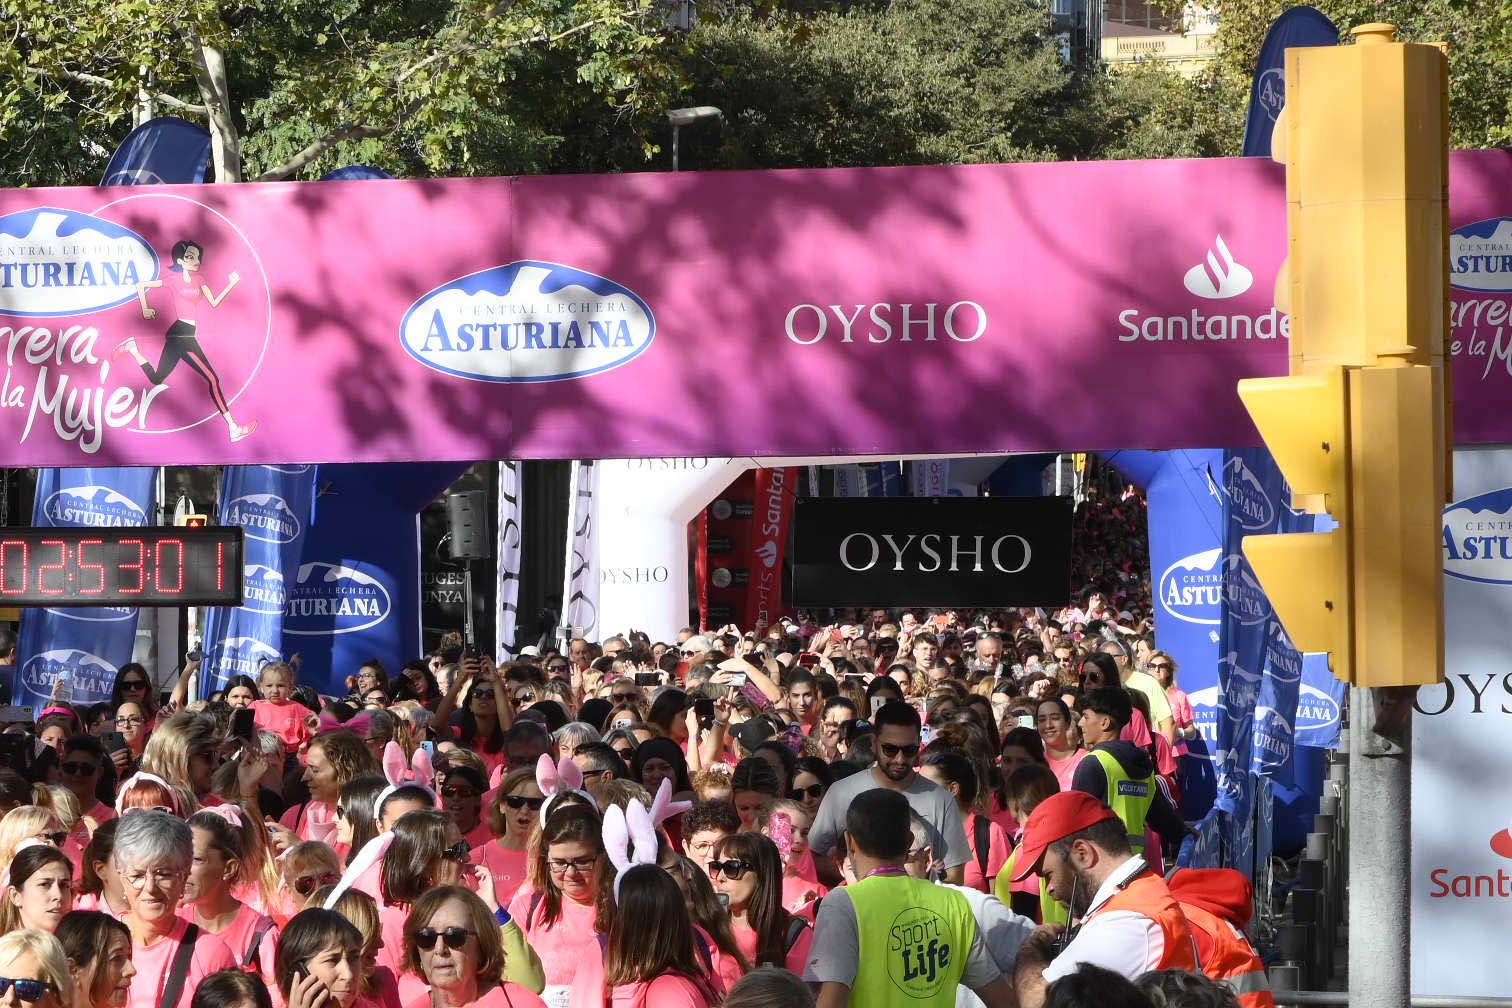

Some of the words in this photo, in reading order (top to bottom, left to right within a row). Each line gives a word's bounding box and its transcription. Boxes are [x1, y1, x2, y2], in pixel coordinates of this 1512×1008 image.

[63, 244, 135, 257] LECHERA
[457, 303, 538, 316] CENTRAL
[545, 300, 627, 315] LECHERA
[785, 300, 988, 345] OYSHO
[1118, 307, 1289, 342] Santande
[419, 309, 635, 354] ASTURIANA
[1468, 329, 1486, 357] la
[0, 366, 25, 408] la
[19, 358, 169, 454] Mujer
[1465, 521, 1512, 533] CENT
[0, 539, 222, 593] 02:53:01
[838, 532, 1032, 573] OYSHO
[327, 587, 378, 595] LECHERA
[1183, 575, 1223, 583] CENTRA
[288, 597, 382, 617] TURIANA
[891, 916, 941, 952] Sport
[902, 938, 950, 983] Life
